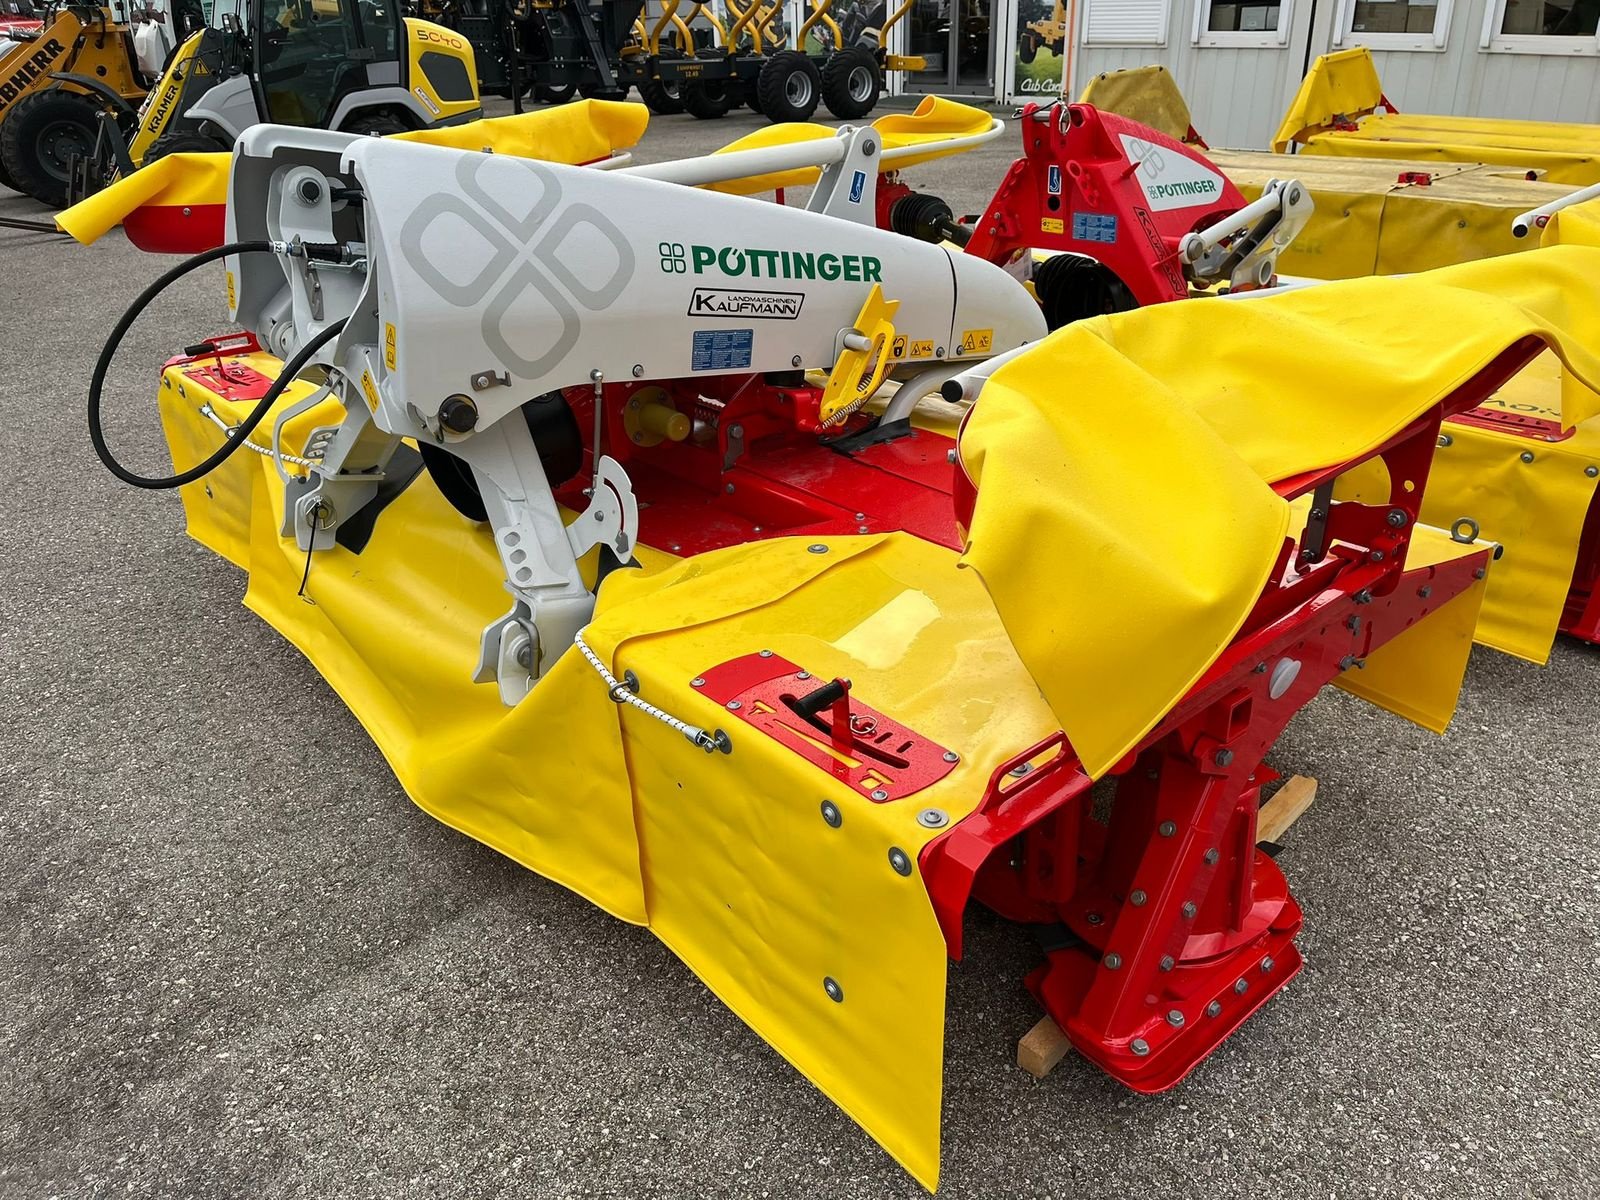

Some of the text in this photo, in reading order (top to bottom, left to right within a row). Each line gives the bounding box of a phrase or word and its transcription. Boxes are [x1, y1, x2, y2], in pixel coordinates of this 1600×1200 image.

[1021, 78, 1040, 92] Cub
[147, 85, 179, 134] KRAMER
[691, 245, 883, 282] PÖTTINGER
[695, 294, 796, 315] KAUFMANN
[727, 295, 797, 304] LANDMASCHINEN
